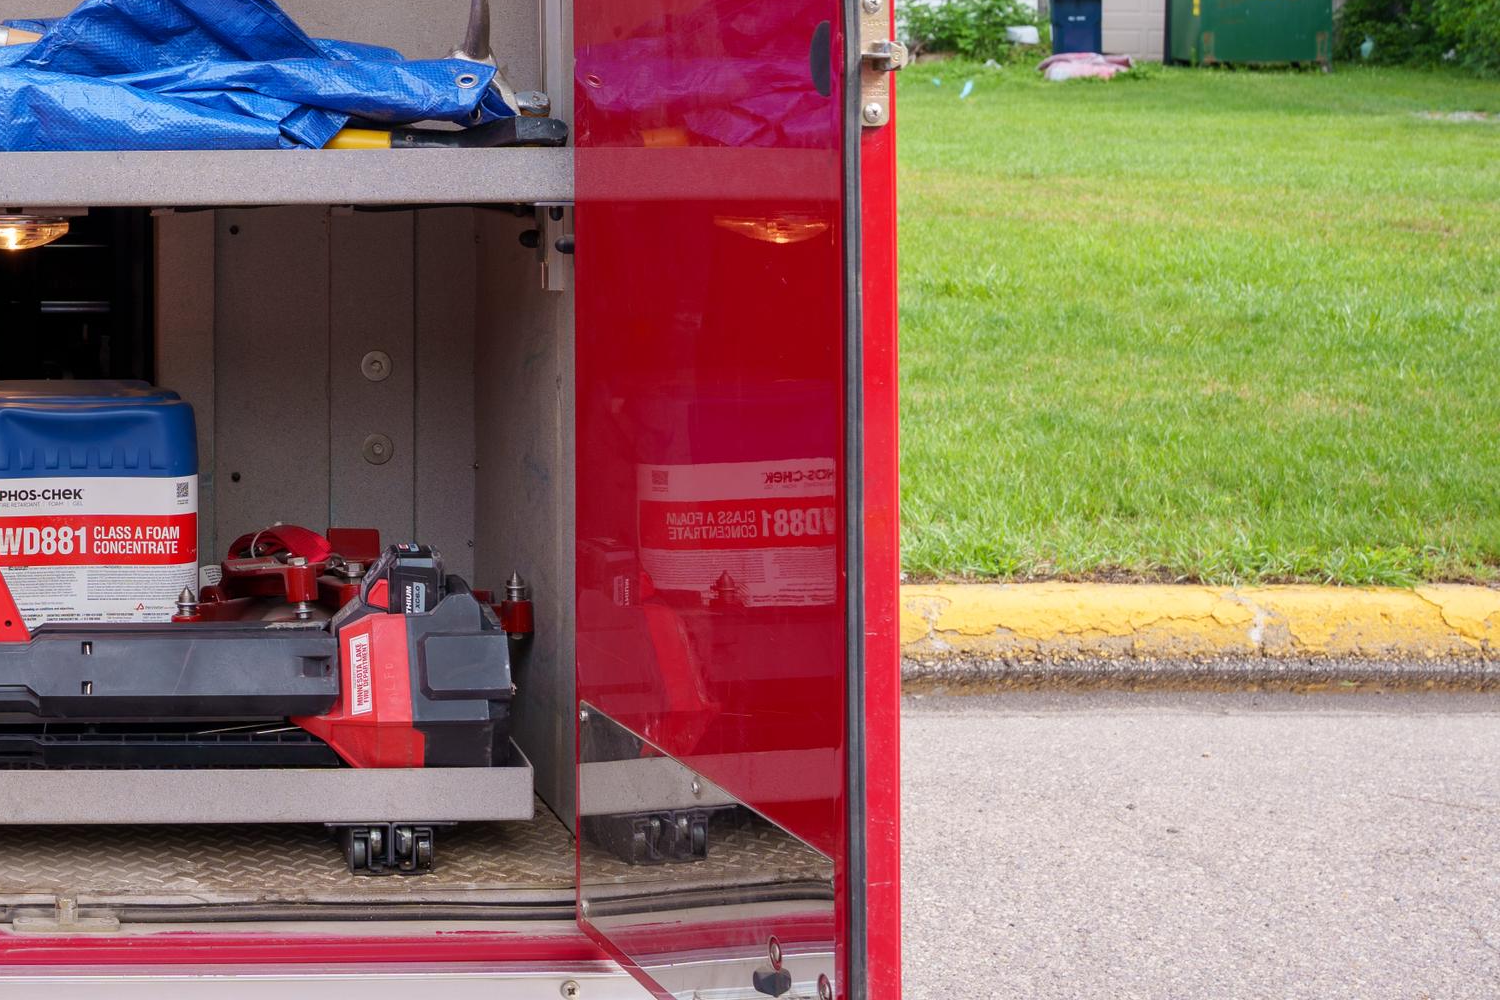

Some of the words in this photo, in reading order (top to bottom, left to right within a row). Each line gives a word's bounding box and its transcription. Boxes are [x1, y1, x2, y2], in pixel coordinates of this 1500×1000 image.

[0, 488, 84, 502] PHOS-CHeK
[94, 526, 131, 540] CLASS
[135, 527, 143, 540] A
[146, 526, 180, 540] FOAM
[94, 541, 178, 554] CONCENTRATE
